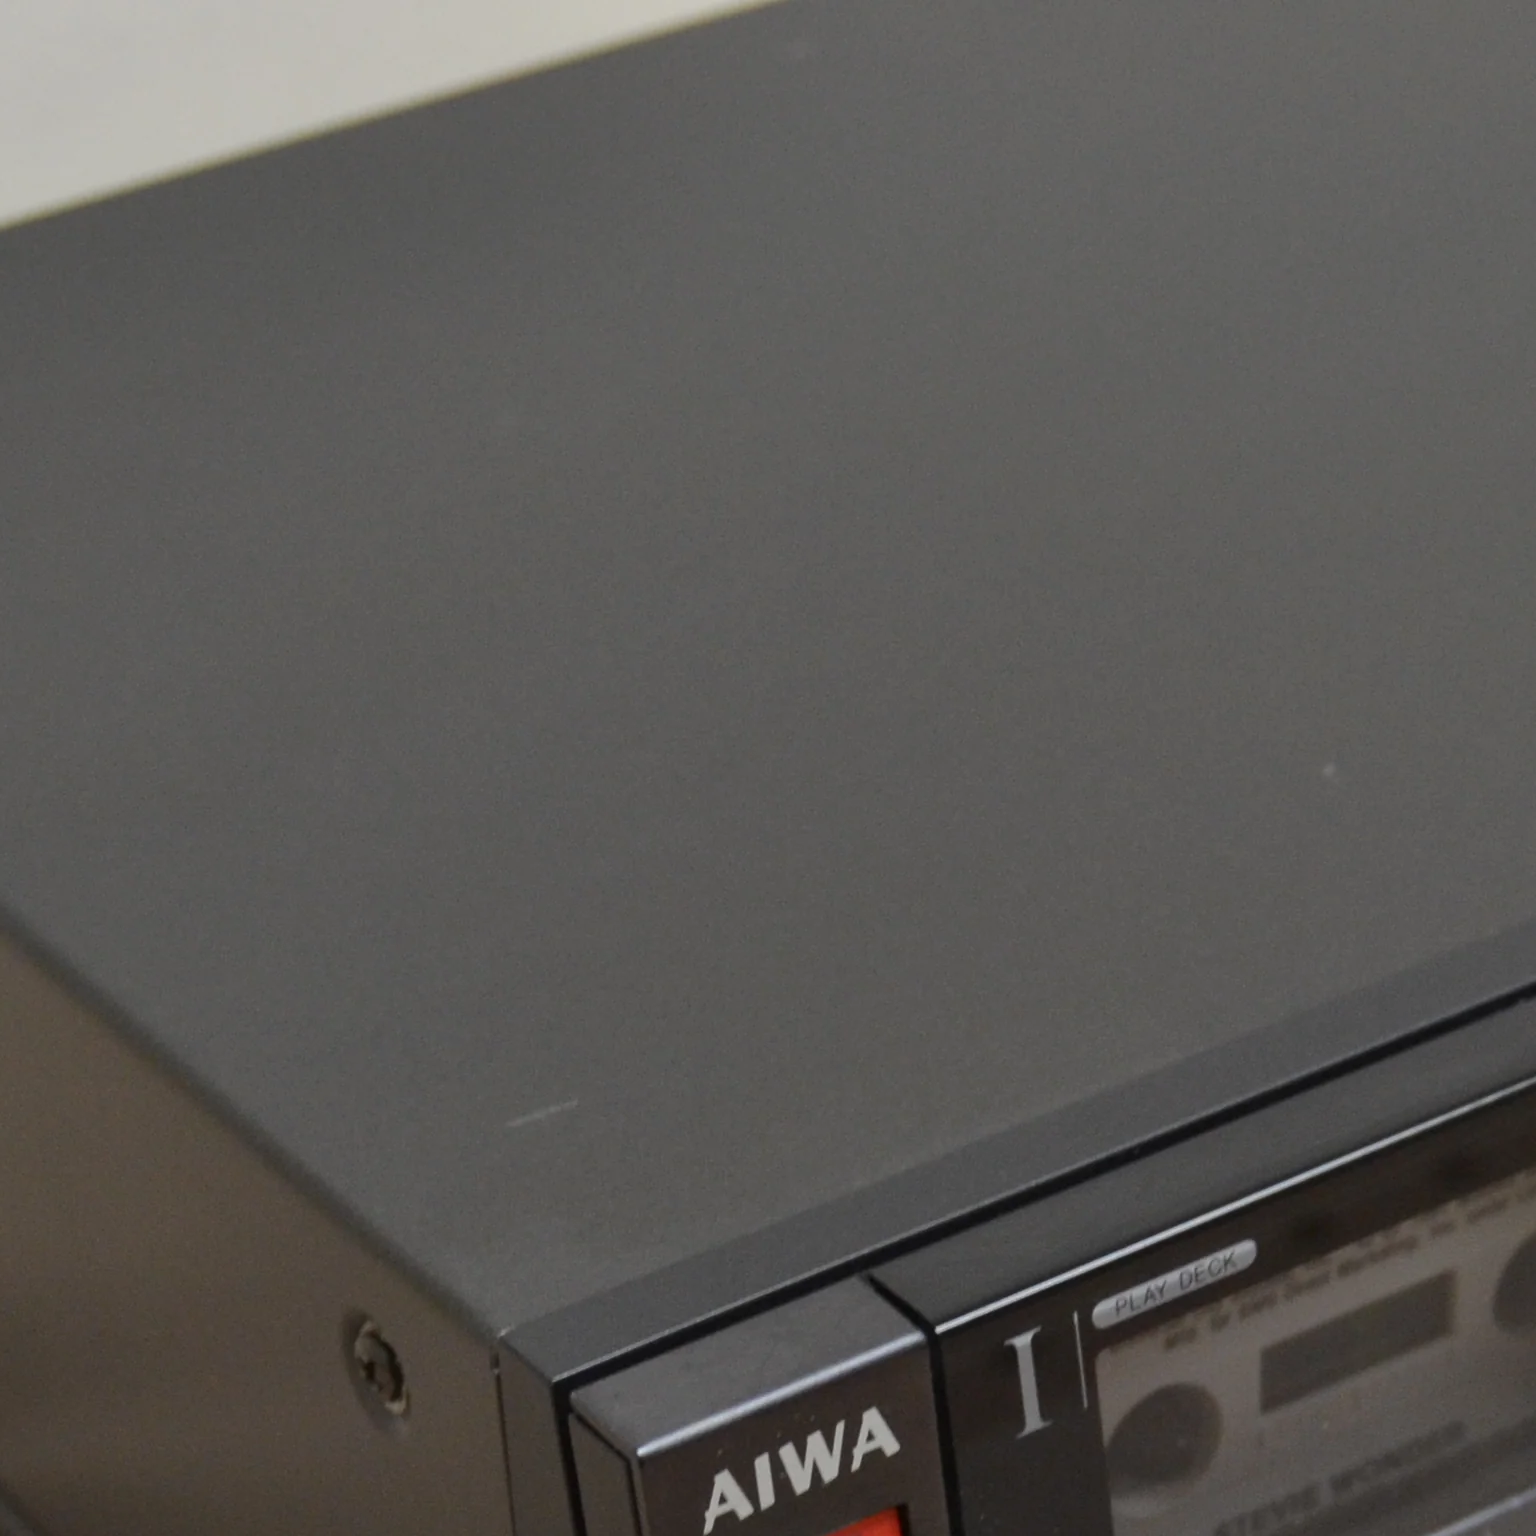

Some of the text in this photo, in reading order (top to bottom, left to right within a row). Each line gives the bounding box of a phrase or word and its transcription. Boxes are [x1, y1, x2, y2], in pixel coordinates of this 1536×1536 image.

[1114, 1249, 1238, 1317] PLAY DECK
[1004, 1326, 1052, 1440] I
[703, 1406, 901, 1536] AIWA
